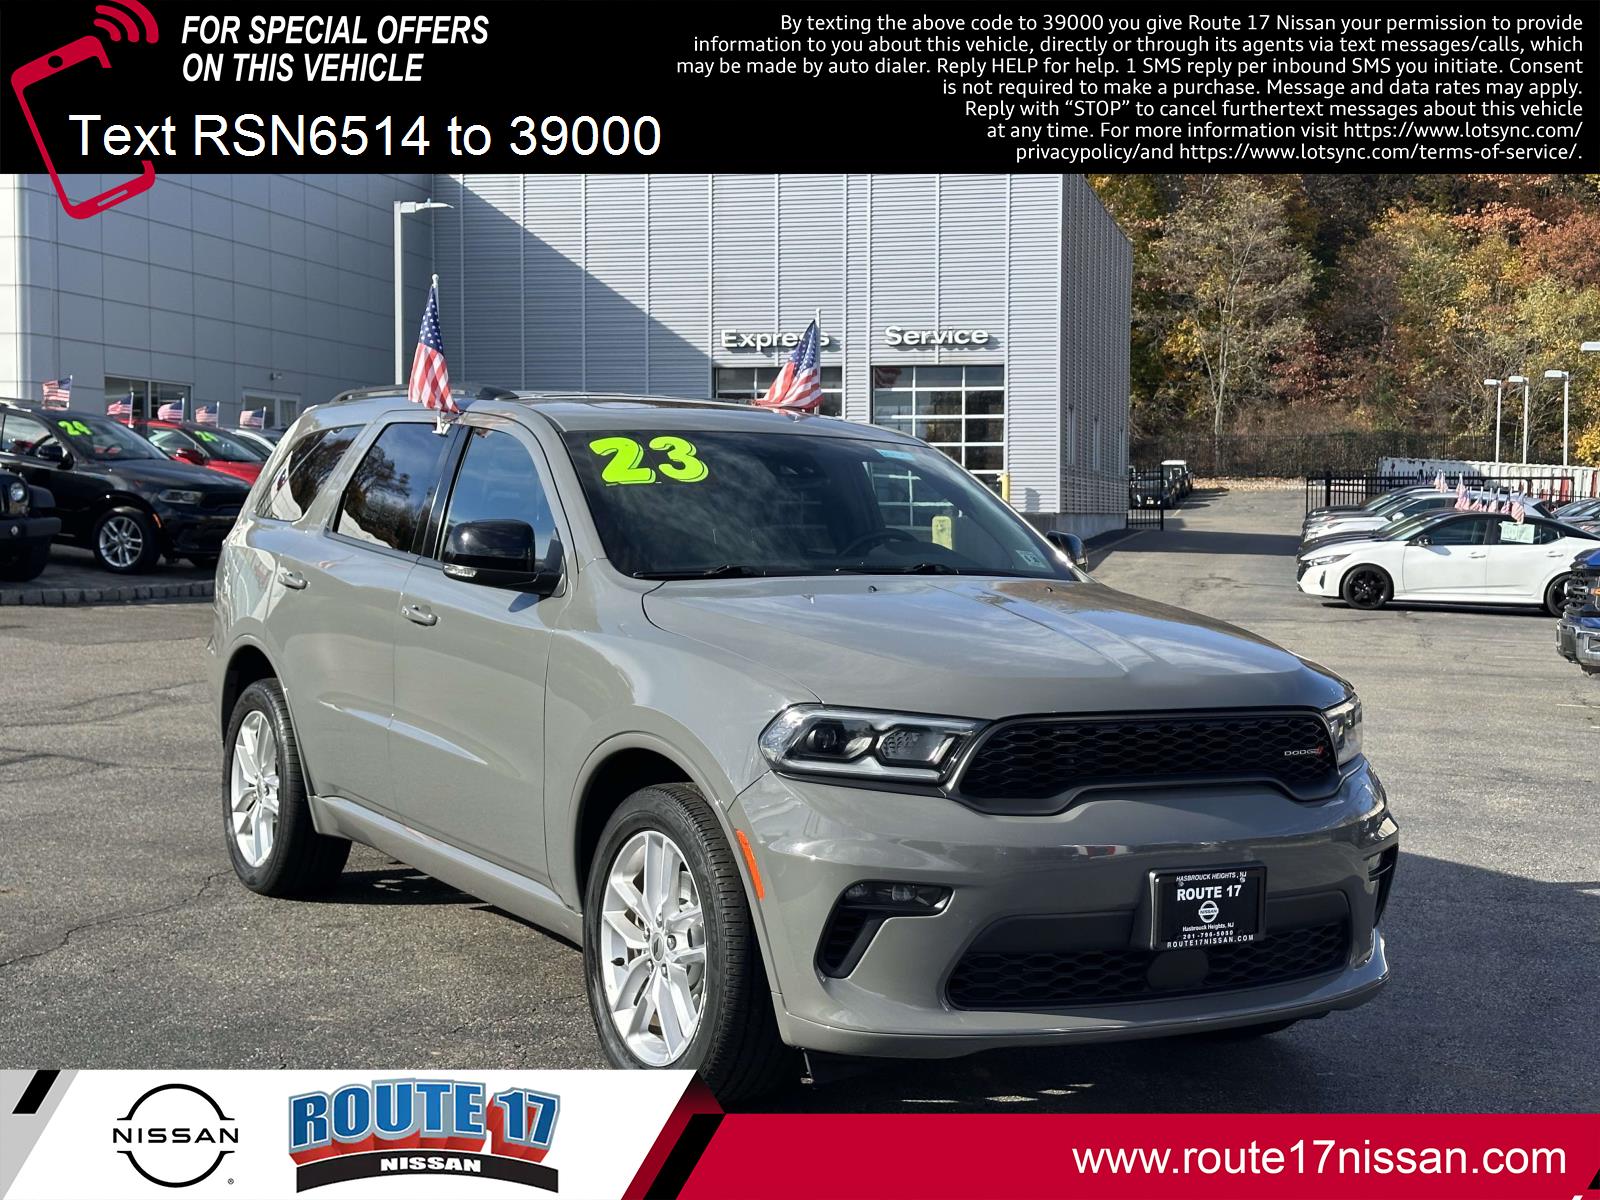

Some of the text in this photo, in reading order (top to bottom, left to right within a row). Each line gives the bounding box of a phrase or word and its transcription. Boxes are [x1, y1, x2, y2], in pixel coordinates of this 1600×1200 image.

[721, 326, 989, 351] Expres Service
[589, 436, 709, 484] 23
[1177, 885, 1242, 901] ROUTE 17
[1167, 934, 1254, 949] ROUTE17NISSAN.COM
